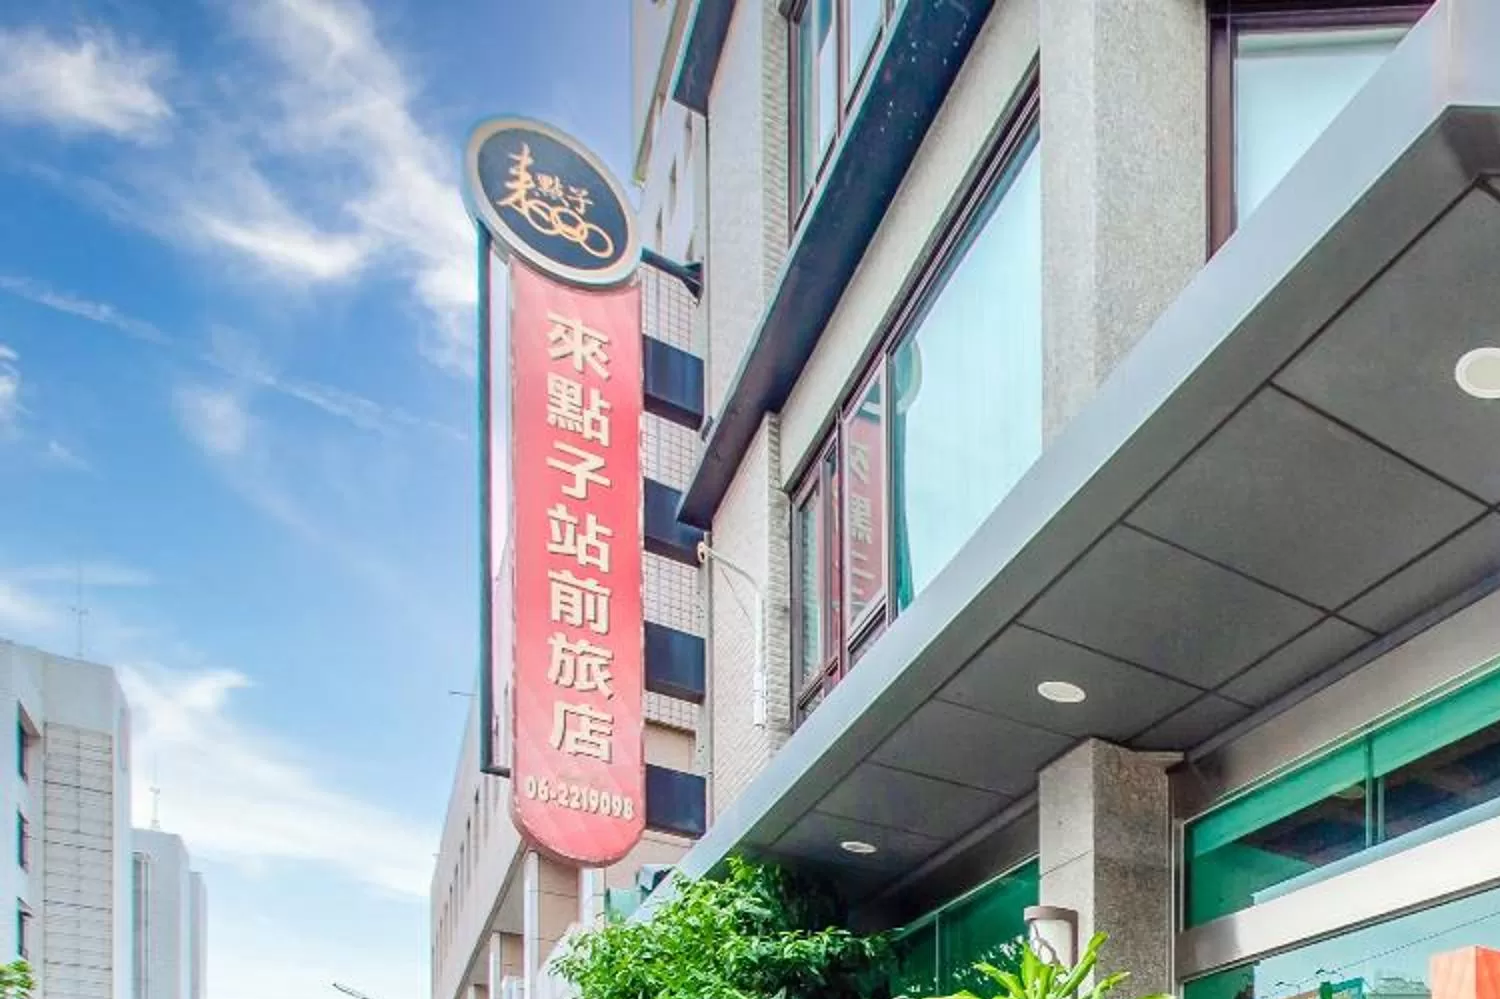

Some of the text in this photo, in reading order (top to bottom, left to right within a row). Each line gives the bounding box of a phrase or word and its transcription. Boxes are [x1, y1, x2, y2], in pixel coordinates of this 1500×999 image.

[547, 312, 613, 764] 來點子站前旅店
[525, 776, 634, 820] 06-2219098
